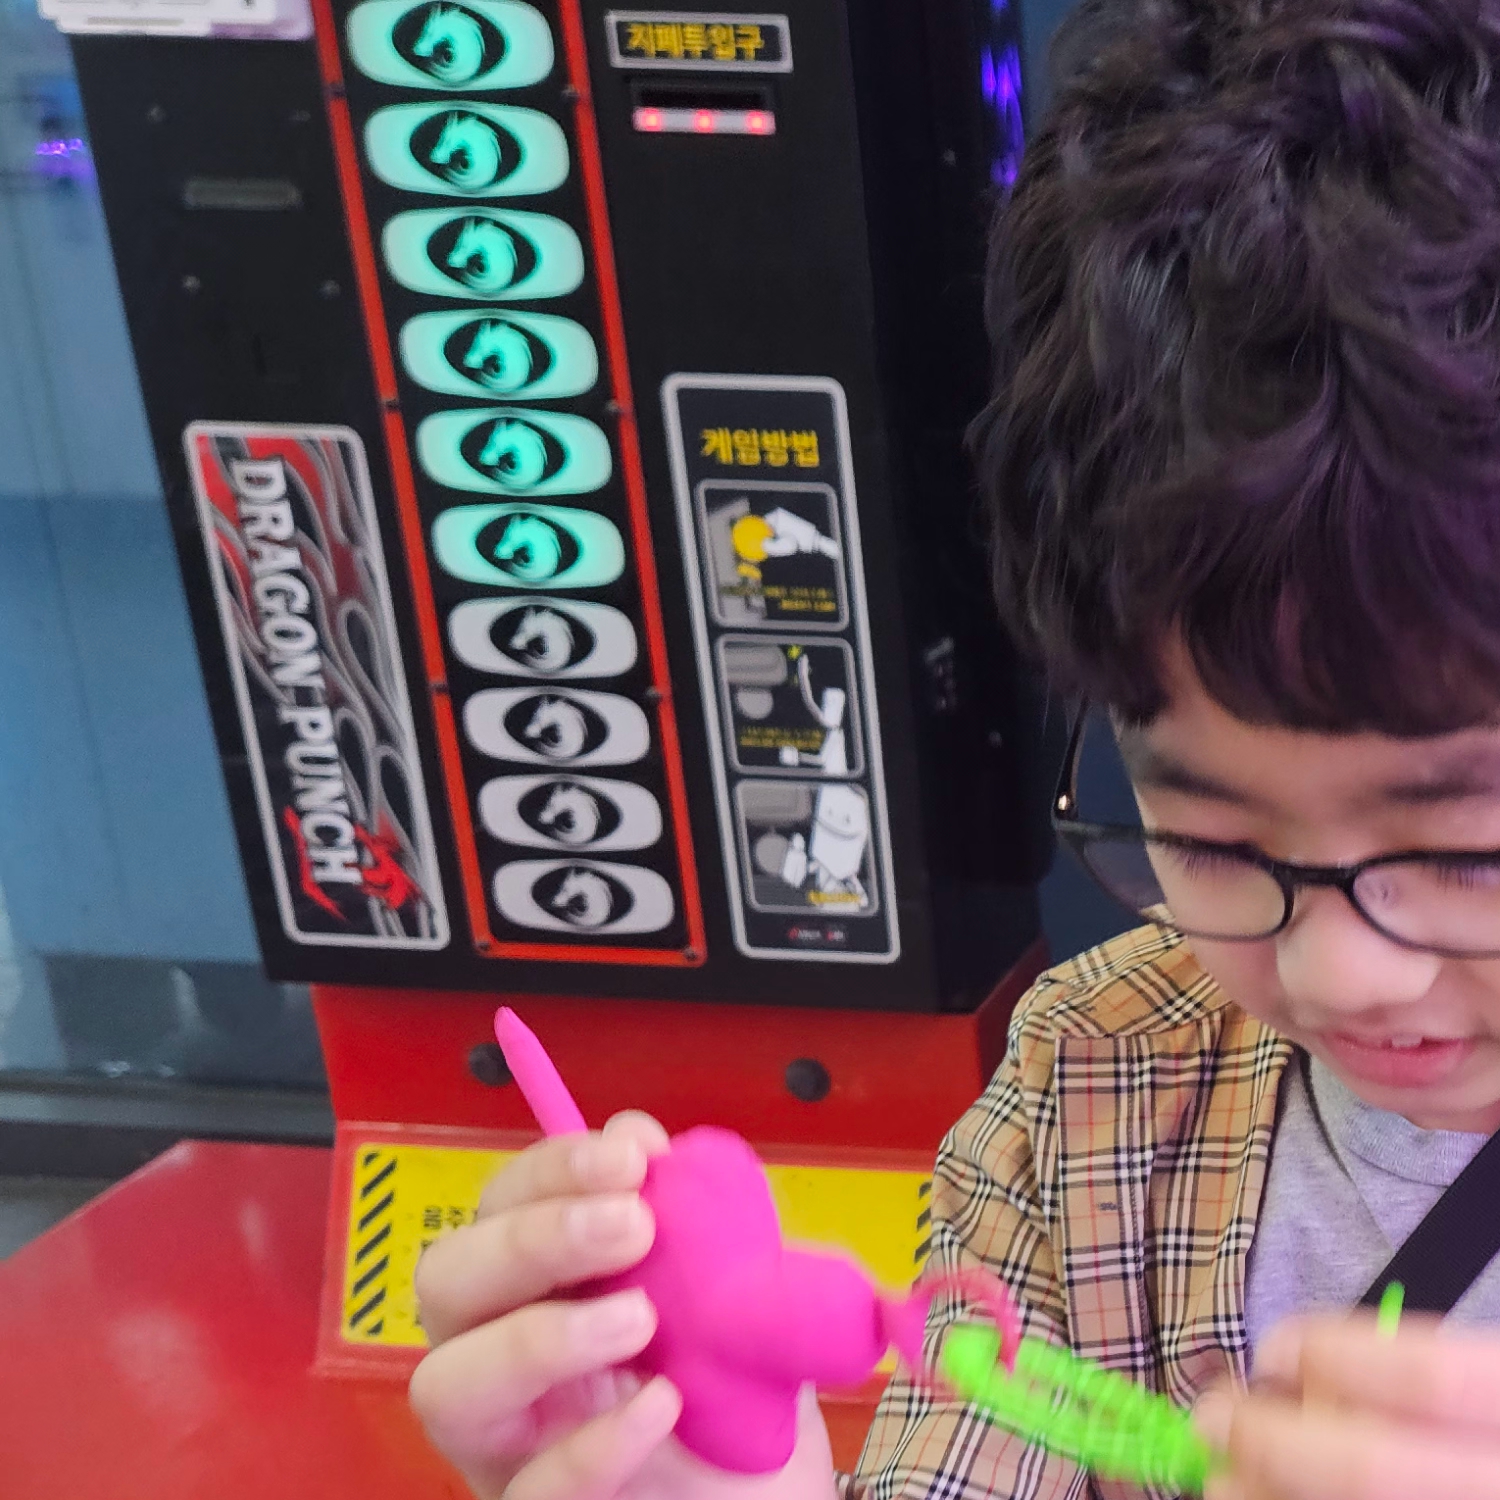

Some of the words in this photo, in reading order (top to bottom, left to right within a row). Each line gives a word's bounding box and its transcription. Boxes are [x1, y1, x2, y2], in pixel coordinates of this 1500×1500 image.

[701, 428, 820, 468] 게임방법
[231, 457, 326, 692] DRAGON
[279, 705, 363, 885] PUNCH
